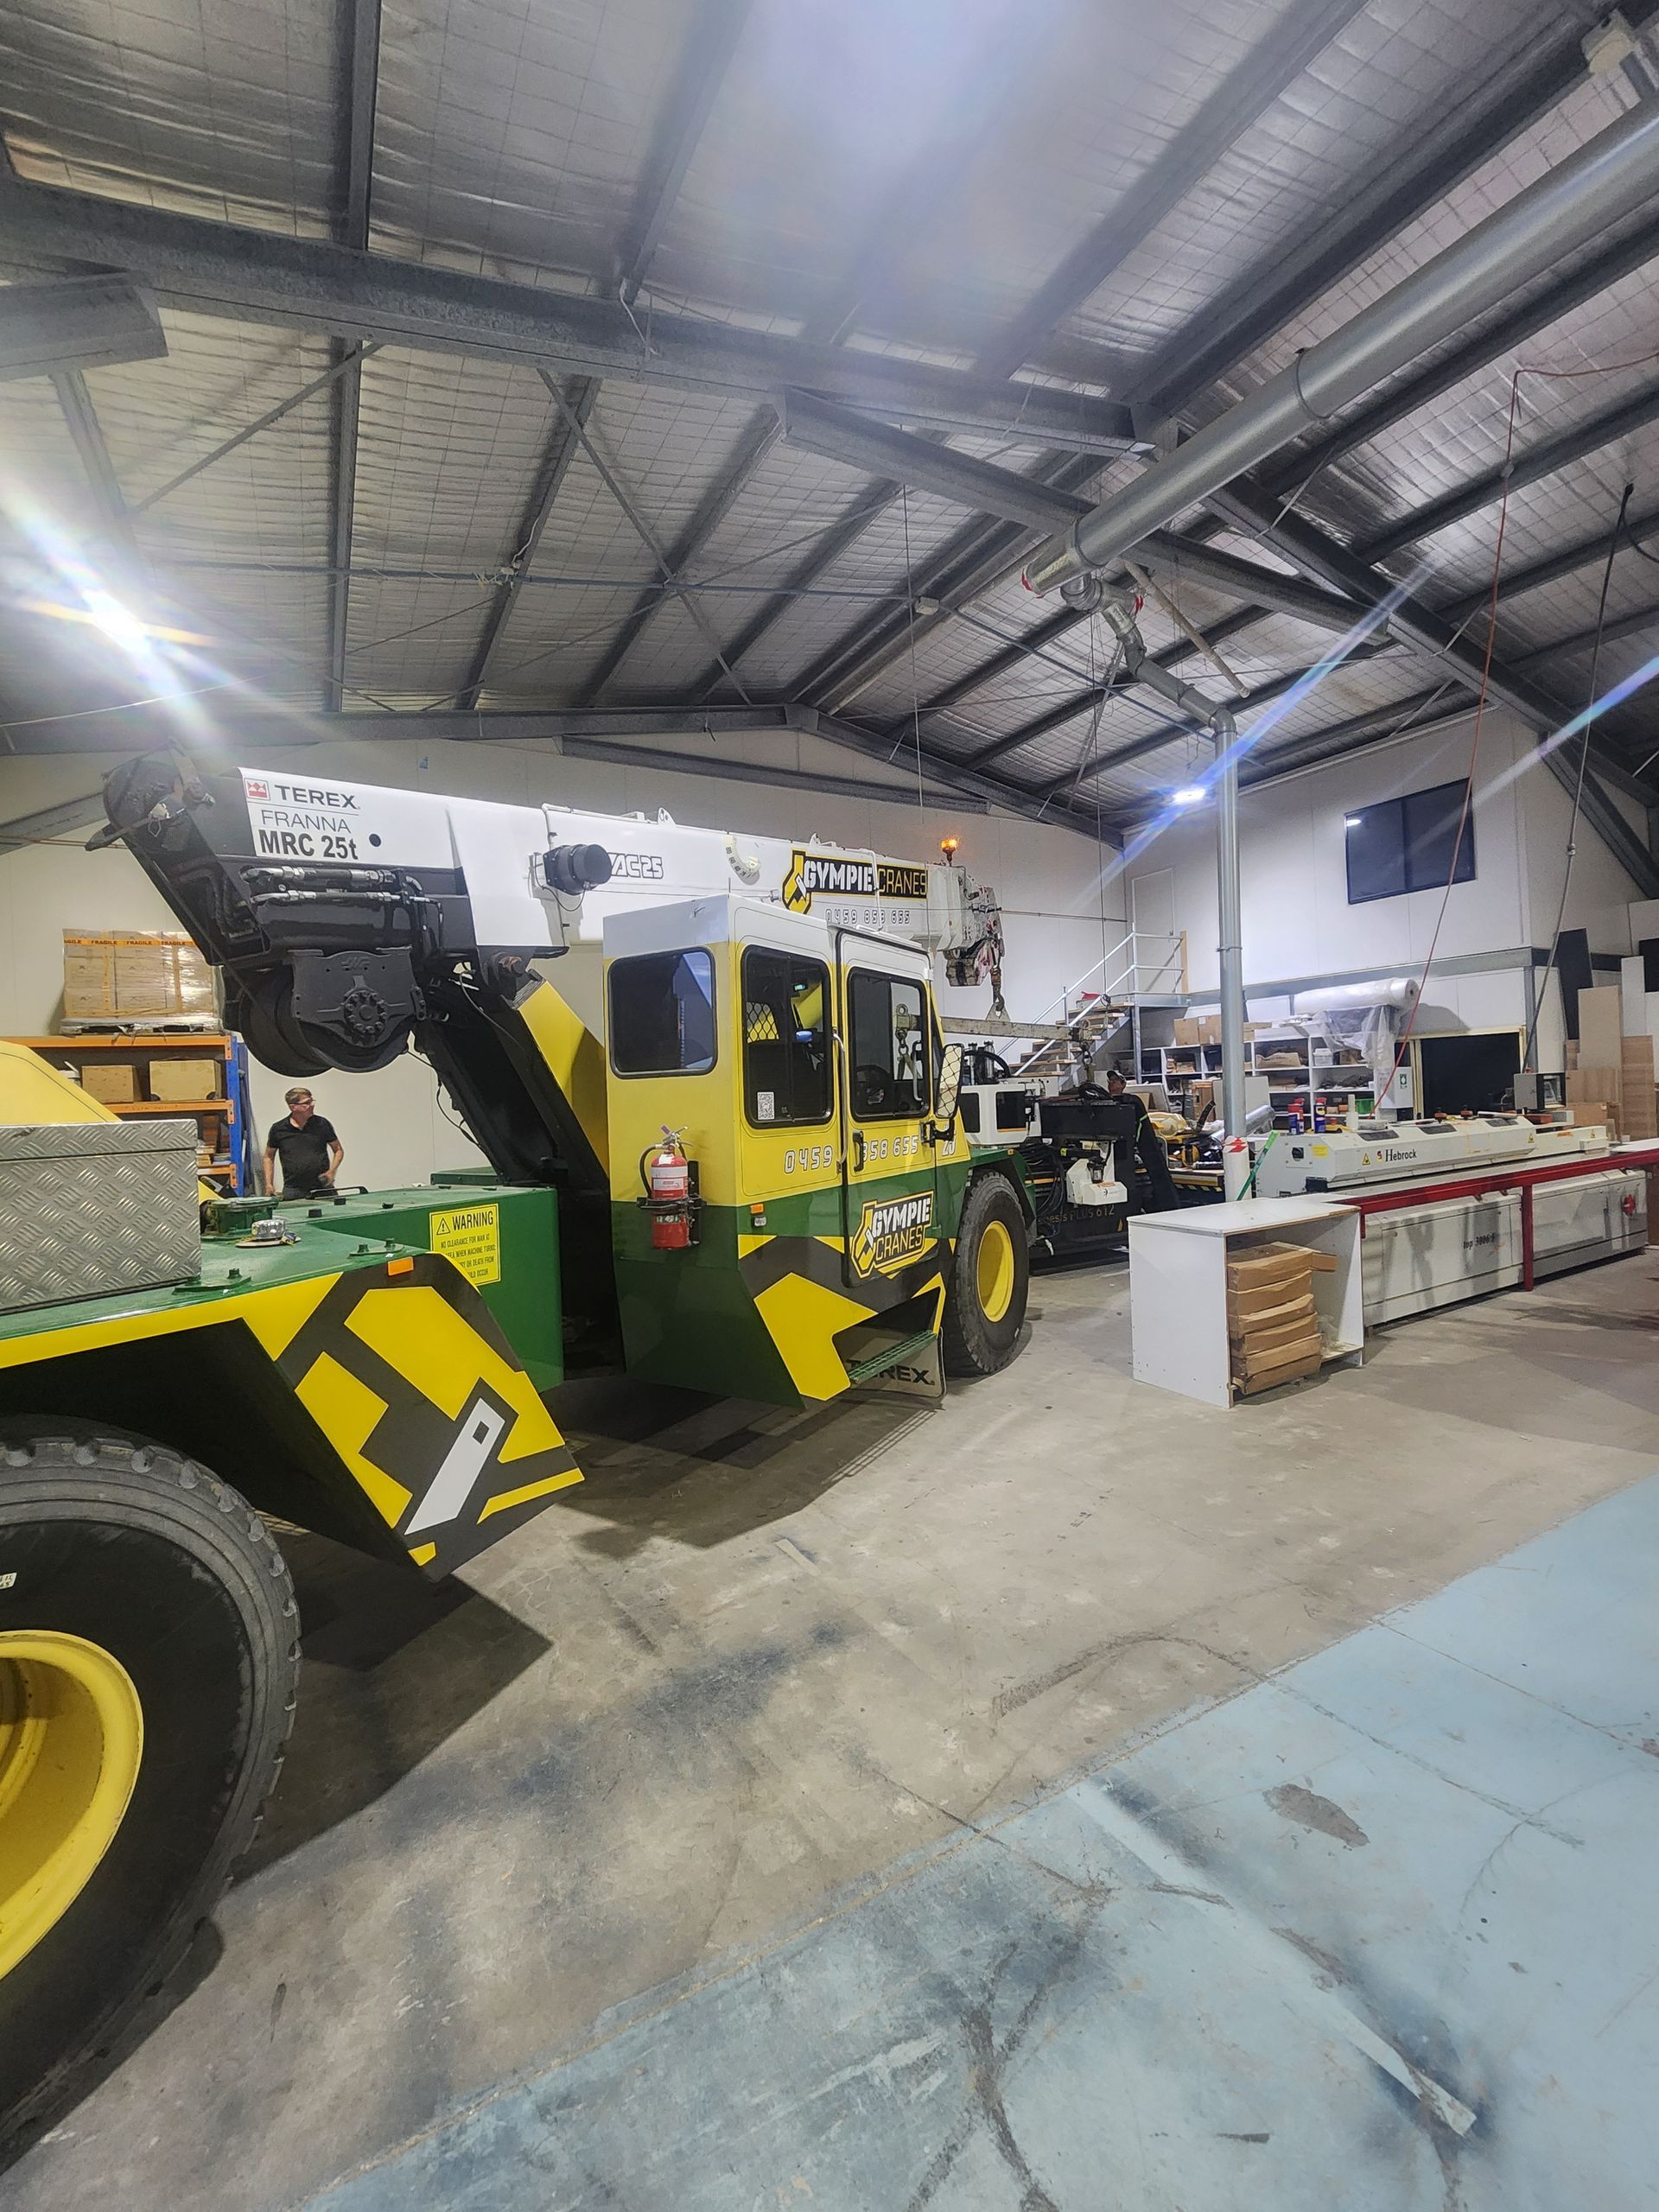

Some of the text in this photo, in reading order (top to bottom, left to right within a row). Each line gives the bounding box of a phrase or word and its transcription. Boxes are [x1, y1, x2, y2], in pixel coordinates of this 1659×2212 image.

[275, 785, 357, 810] TEREX
[261, 810, 352, 834] FRANNA
[258, 829, 359, 860] MRC 25t
[607, 852, 664, 880] AC25
[804, 860, 926, 896] GYMPIE CRANES
[825, 907, 858, 925] 0459
[891, 910, 911, 925] 655
[784, 1145, 833, 1174] 0459
[893, 1135, 919, 1158] 655
[1385, 1148, 1417, 1163] Hebrock
[452, 1211, 493, 1230] WARNING
[872, 1196, 931, 1238] GYMPIE
[447, 1236, 468, 1248] CLEARANCE
[468, 1236, 477, 1244] FOR
[455, 1249, 467, 1258] WHEN
[467, 1246, 483, 1256] MACHINE
[874, 1225, 924, 1261] CRANES
[473, 1258, 484, 1267] DEATH
[485, 1255, 494, 1264] FROM
[477, 1268, 489, 1277] OCCUR
[846, 1359, 930, 1386] TREX
